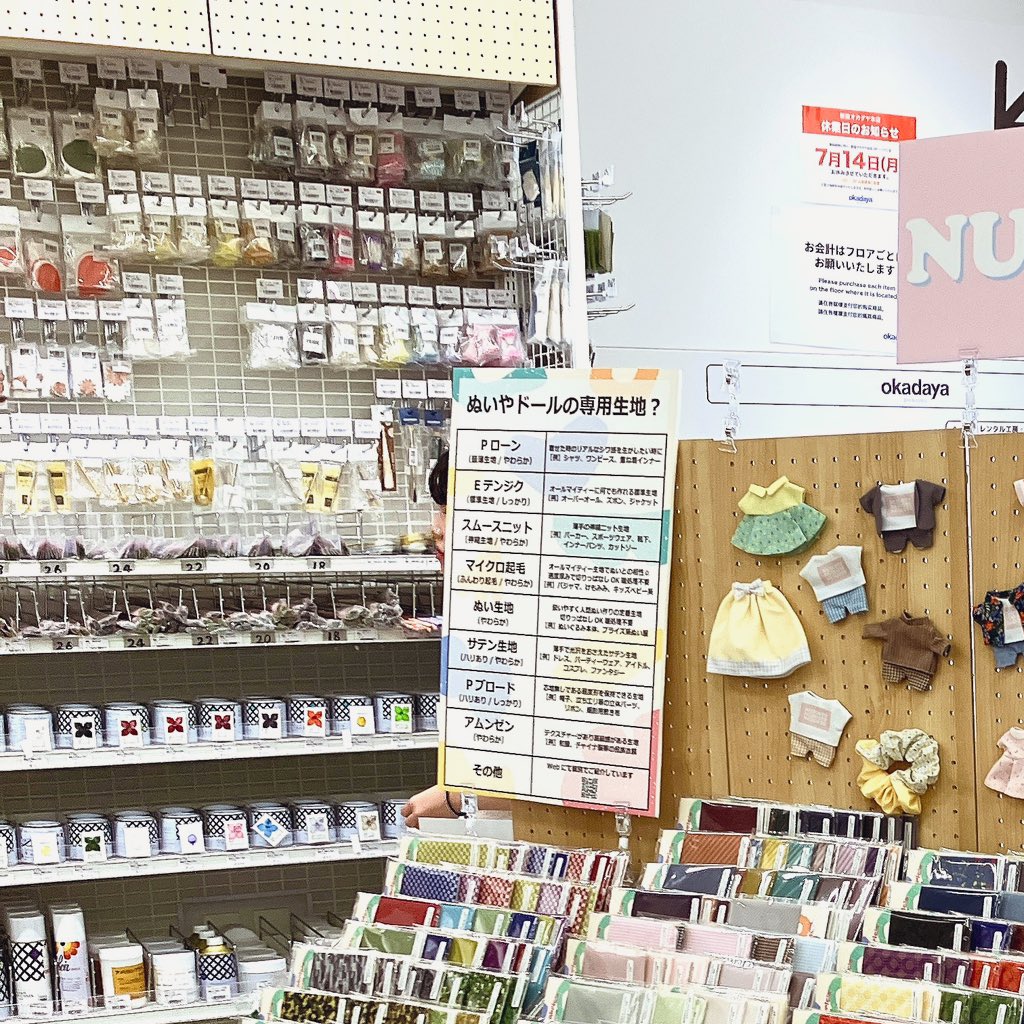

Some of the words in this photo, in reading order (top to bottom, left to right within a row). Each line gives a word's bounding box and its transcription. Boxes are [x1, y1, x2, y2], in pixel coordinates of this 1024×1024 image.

[821, 120, 899, 140] 休業日のお知らせ
[818, 278, 838, 286] Please
[838, 280, 866, 289] purchase
[881, 378, 950, 399] okadaya
[466, 395, 660, 416] ぬいやドールの専用生地?
[461, 518, 532, 534] スムースニット
[112, 564, 133, 572] 24
[186, 563, 203, 571] 22
[465, 558, 526, 574] マイクロ起毛
[473, 599, 514, 614] ぬい生地
[477, 616, 508, 626] (やわらか)
[197, 636, 213, 645] 22
[256, 634, 271, 643] 20
[328, 631, 340, 641] 18
[56, 641, 72, 650] 26
[127, 638, 145, 648] 24
[467, 637, 517, 653] サテン生地
[464, 716, 514, 732] アムンゼン
[473, 732, 504, 744] (やわらか)
[472, 765, 503, 779] その他
